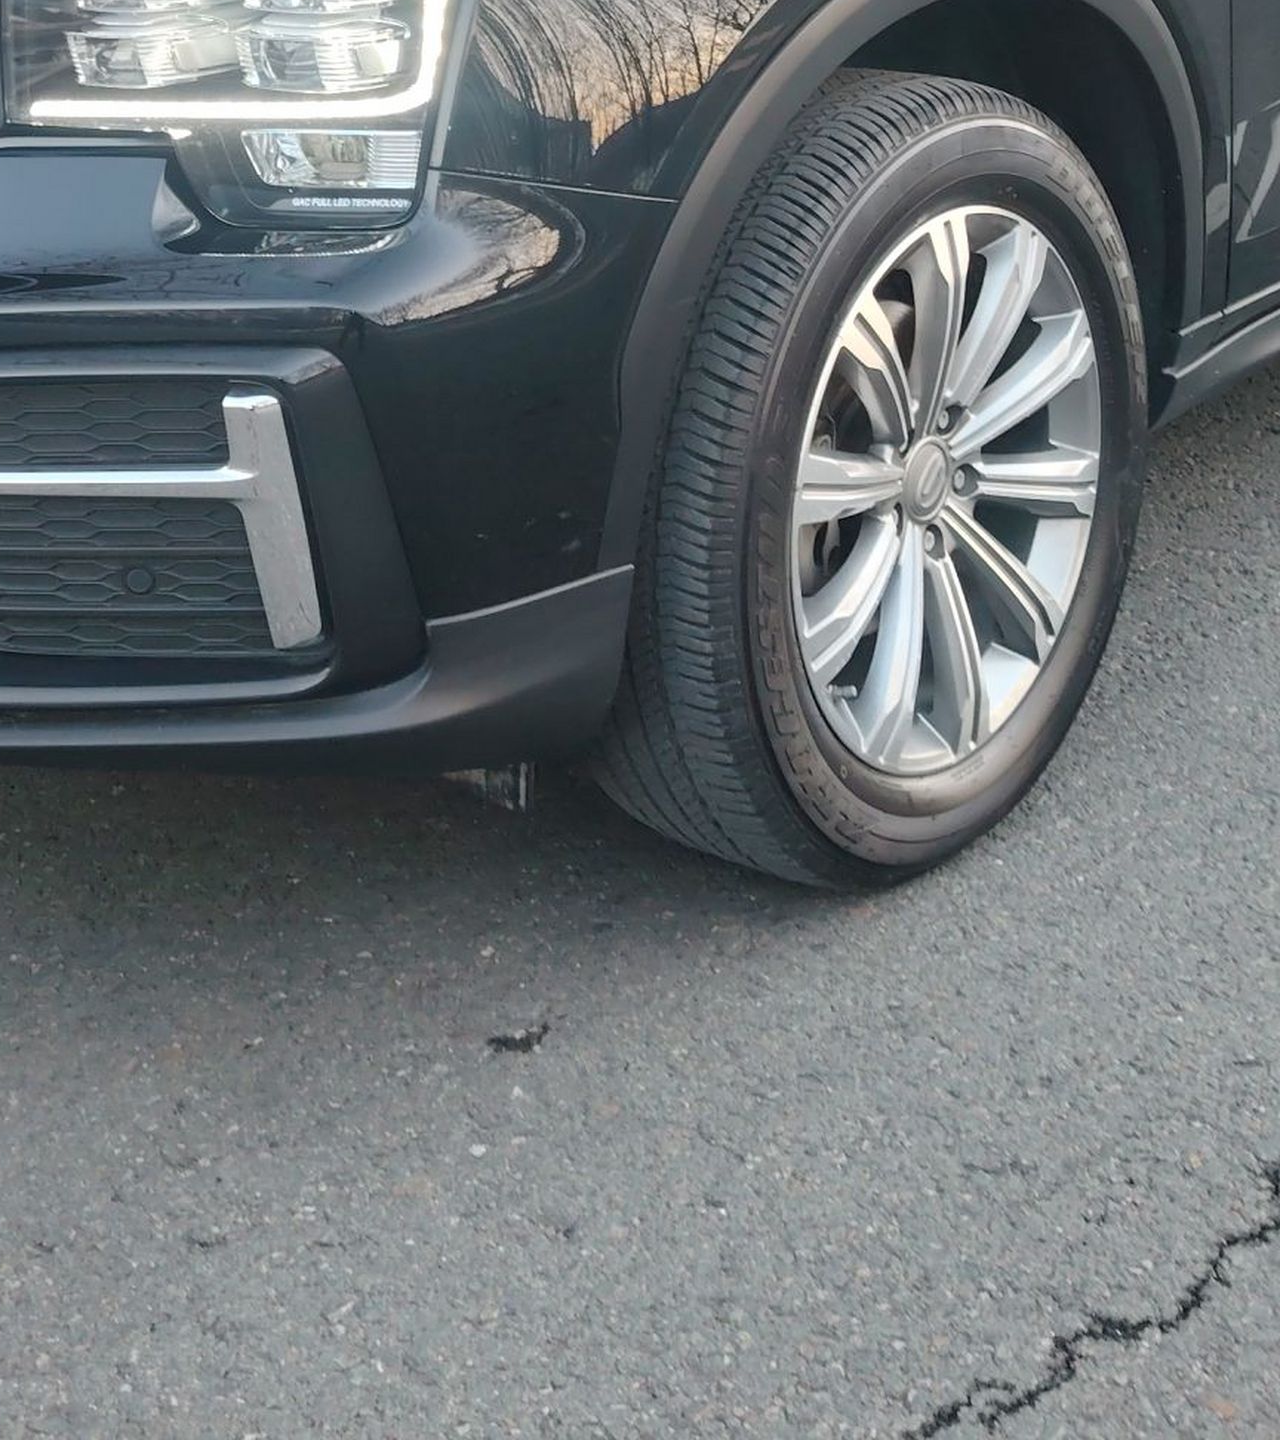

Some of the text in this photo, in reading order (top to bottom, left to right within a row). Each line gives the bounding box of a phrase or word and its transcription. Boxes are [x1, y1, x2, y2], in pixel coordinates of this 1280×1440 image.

[292, 197, 412, 208] GAC FULL LED TECHNOLOGY
